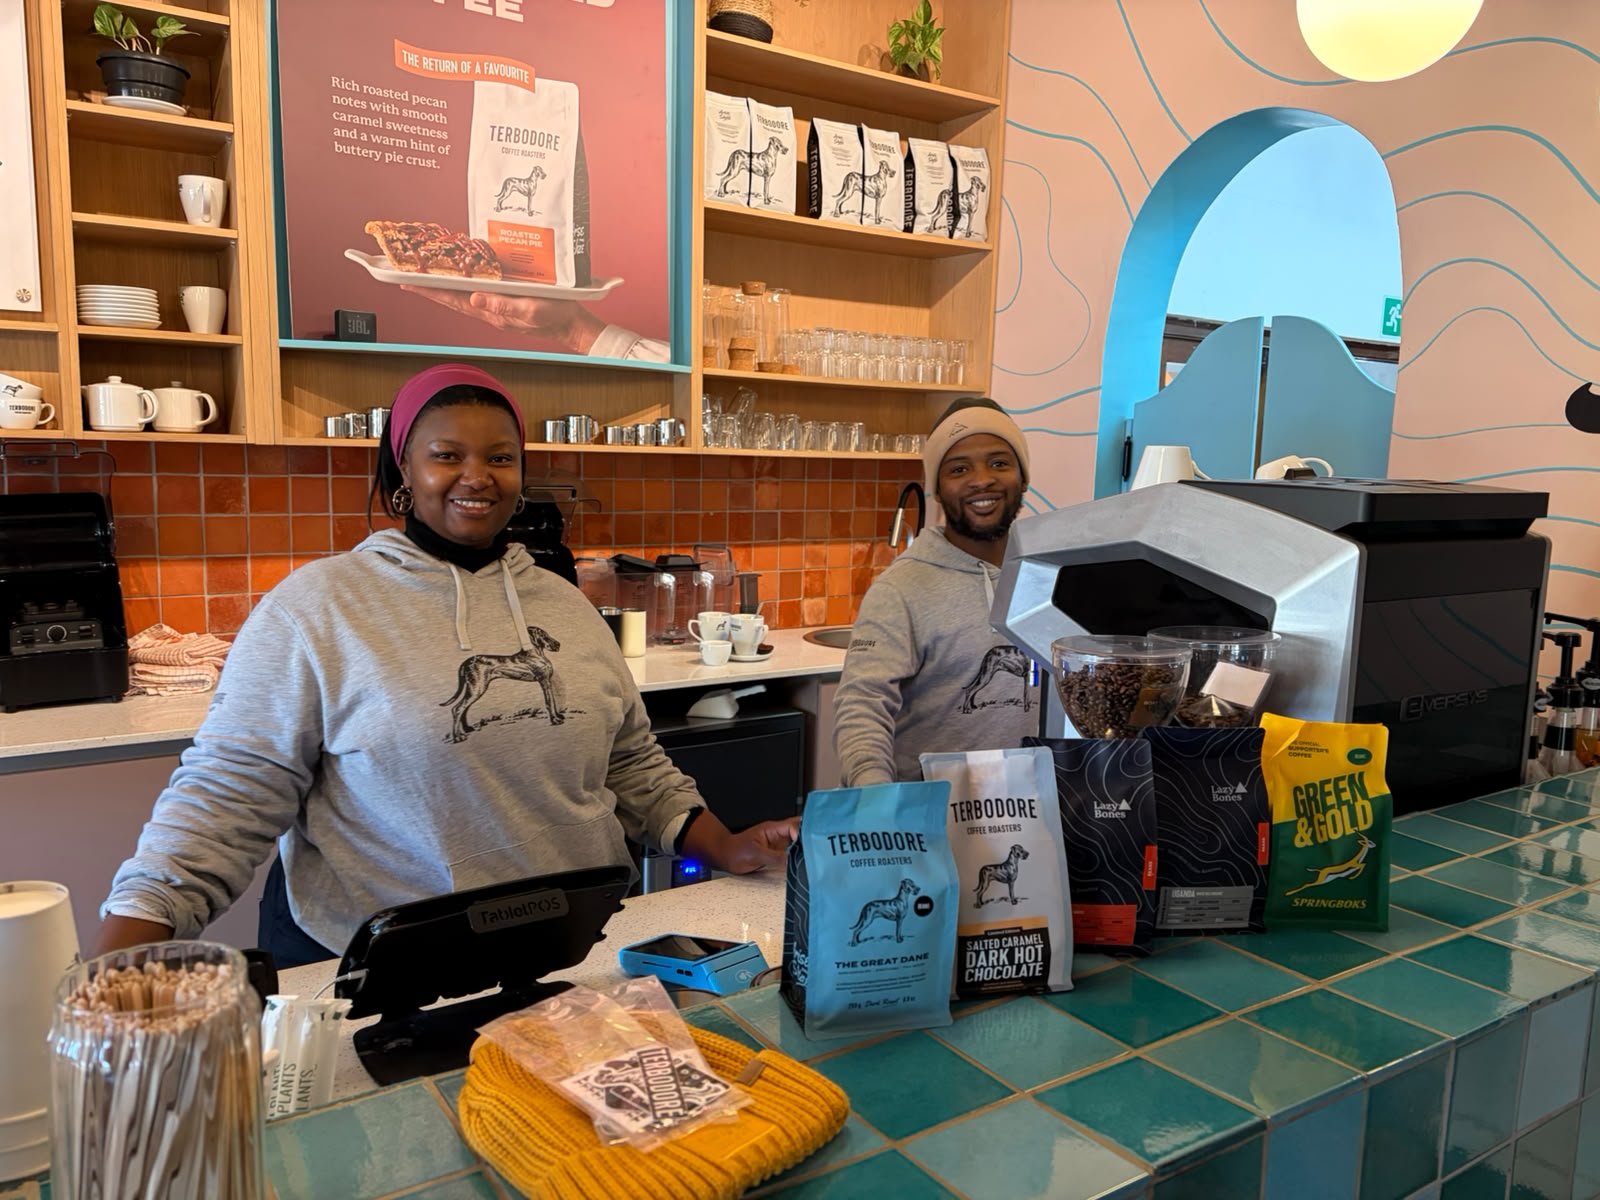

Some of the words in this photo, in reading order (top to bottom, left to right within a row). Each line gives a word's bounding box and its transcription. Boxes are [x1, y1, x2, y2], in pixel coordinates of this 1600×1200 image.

[402, 50, 419, 68] THE
[422, 57, 458, 73] RETURN
[460, 61, 471, 74] OF
[475, 61, 481, 74] A
[484, 61, 529, 84] FAVOURITE
[331, 76, 360, 91] Rich
[363, 85, 409, 101] roasted
[412, 94, 447, 109] pecan
[332, 95, 367, 109] notes
[369, 102, 400, 115] with
[402, 108, 447, 124] smooth
[332, 111, 383, 128] caramel
[385, 121, 448, 139] sweetness
[333, 127, 358, 139] and
[360, 132, 368, 141] a
[370, 133, 408, 148] warm
[410, 138, 435, 153] hint
[437, 145, 451, 155] of
[490, 125, 560, 151] TERBODORE
[334, 141, 382, 161] buttery
[385, 151, 404, 163] pie
[406, 155, 440, 169] crust.
[502, 147, 520, 156] COFFEE
[520, 149, 546, 159] ROASTERS
[499, 236, 527, 246] PECAN
[529, 240, 543, 248] PIE
[501, 229, 540, 240] ROASTED
[348, 319, 370, 335] JBL
[1211, 785, 1233, 795] Lazy
[1212, 793, 1242, 802] Bones
[1293, 771, 1369, 819] GREEN
[950, 798, 1037, 823] TERBODORE
[1094, 801, 1118, 811] Lazy
[1095, 809, 1126, 818] Bones
[967, 825, 987, 835] COFFEE
[988, 824, 1022, 833] ROASTERS
[827, 832, 927, 856] TERBODORE
[850, 858, 876, 868] COFFEE
[878, 856, 912, 866] ROASTERS
[481, 897, 561, 925] TabletPOS
[1292, 897, 1367, 909] SPRINGBOKS
[966, 938, 1000, 951] SALTED
[1002, 934, 1043, 947] CARAMEL
[860, 957, 898, 967] GREAT
[900, 952, 929, 963] DANE
[966, 948, 1009, 968] DARK
[1014, 944, 1044, 965] HOT
[965, 962, 1043, 983] CHOCOLATE
[277, 1063, 297, 1113] PLANTS
[641, 1050, 684, 1118] TERBODORE
